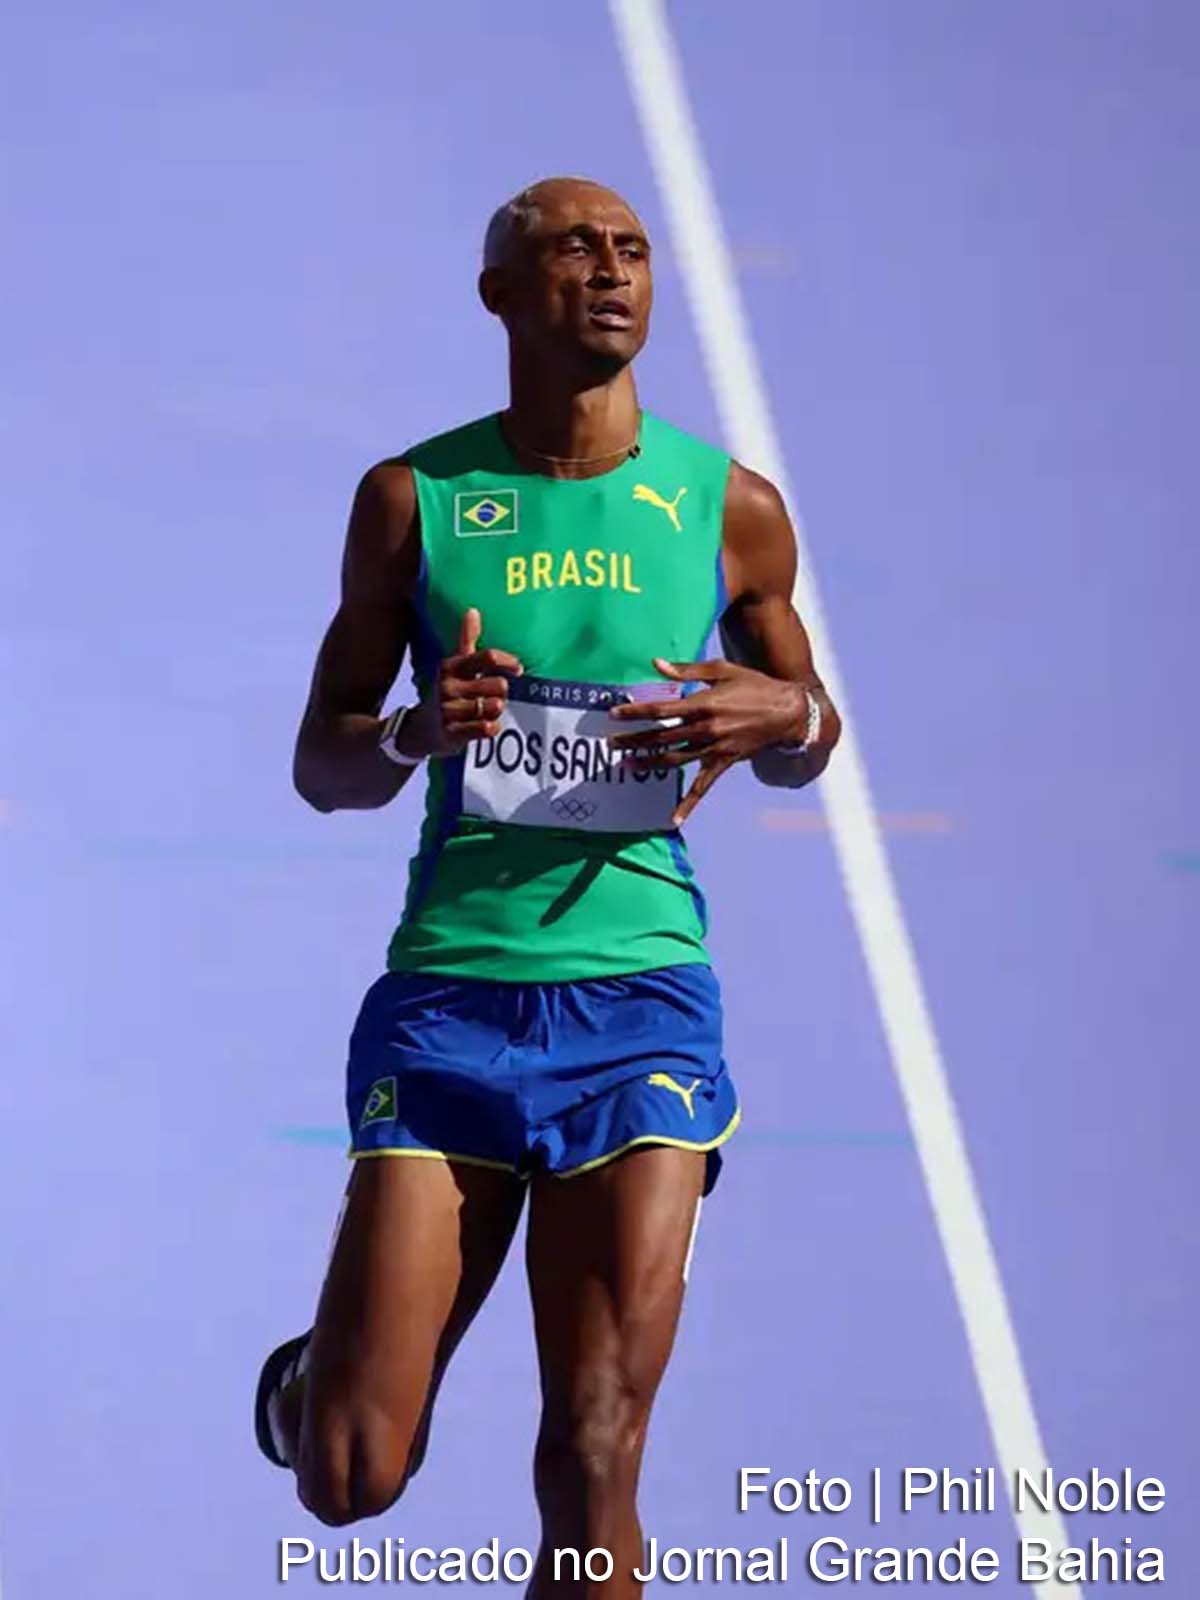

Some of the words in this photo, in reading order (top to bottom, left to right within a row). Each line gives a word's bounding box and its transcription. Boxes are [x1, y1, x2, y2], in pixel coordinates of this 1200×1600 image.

[506, 549, 641, 595] BRASIL
[529, 684, 582, 703] PARIS
[474, 728, 543, 776] DOS
